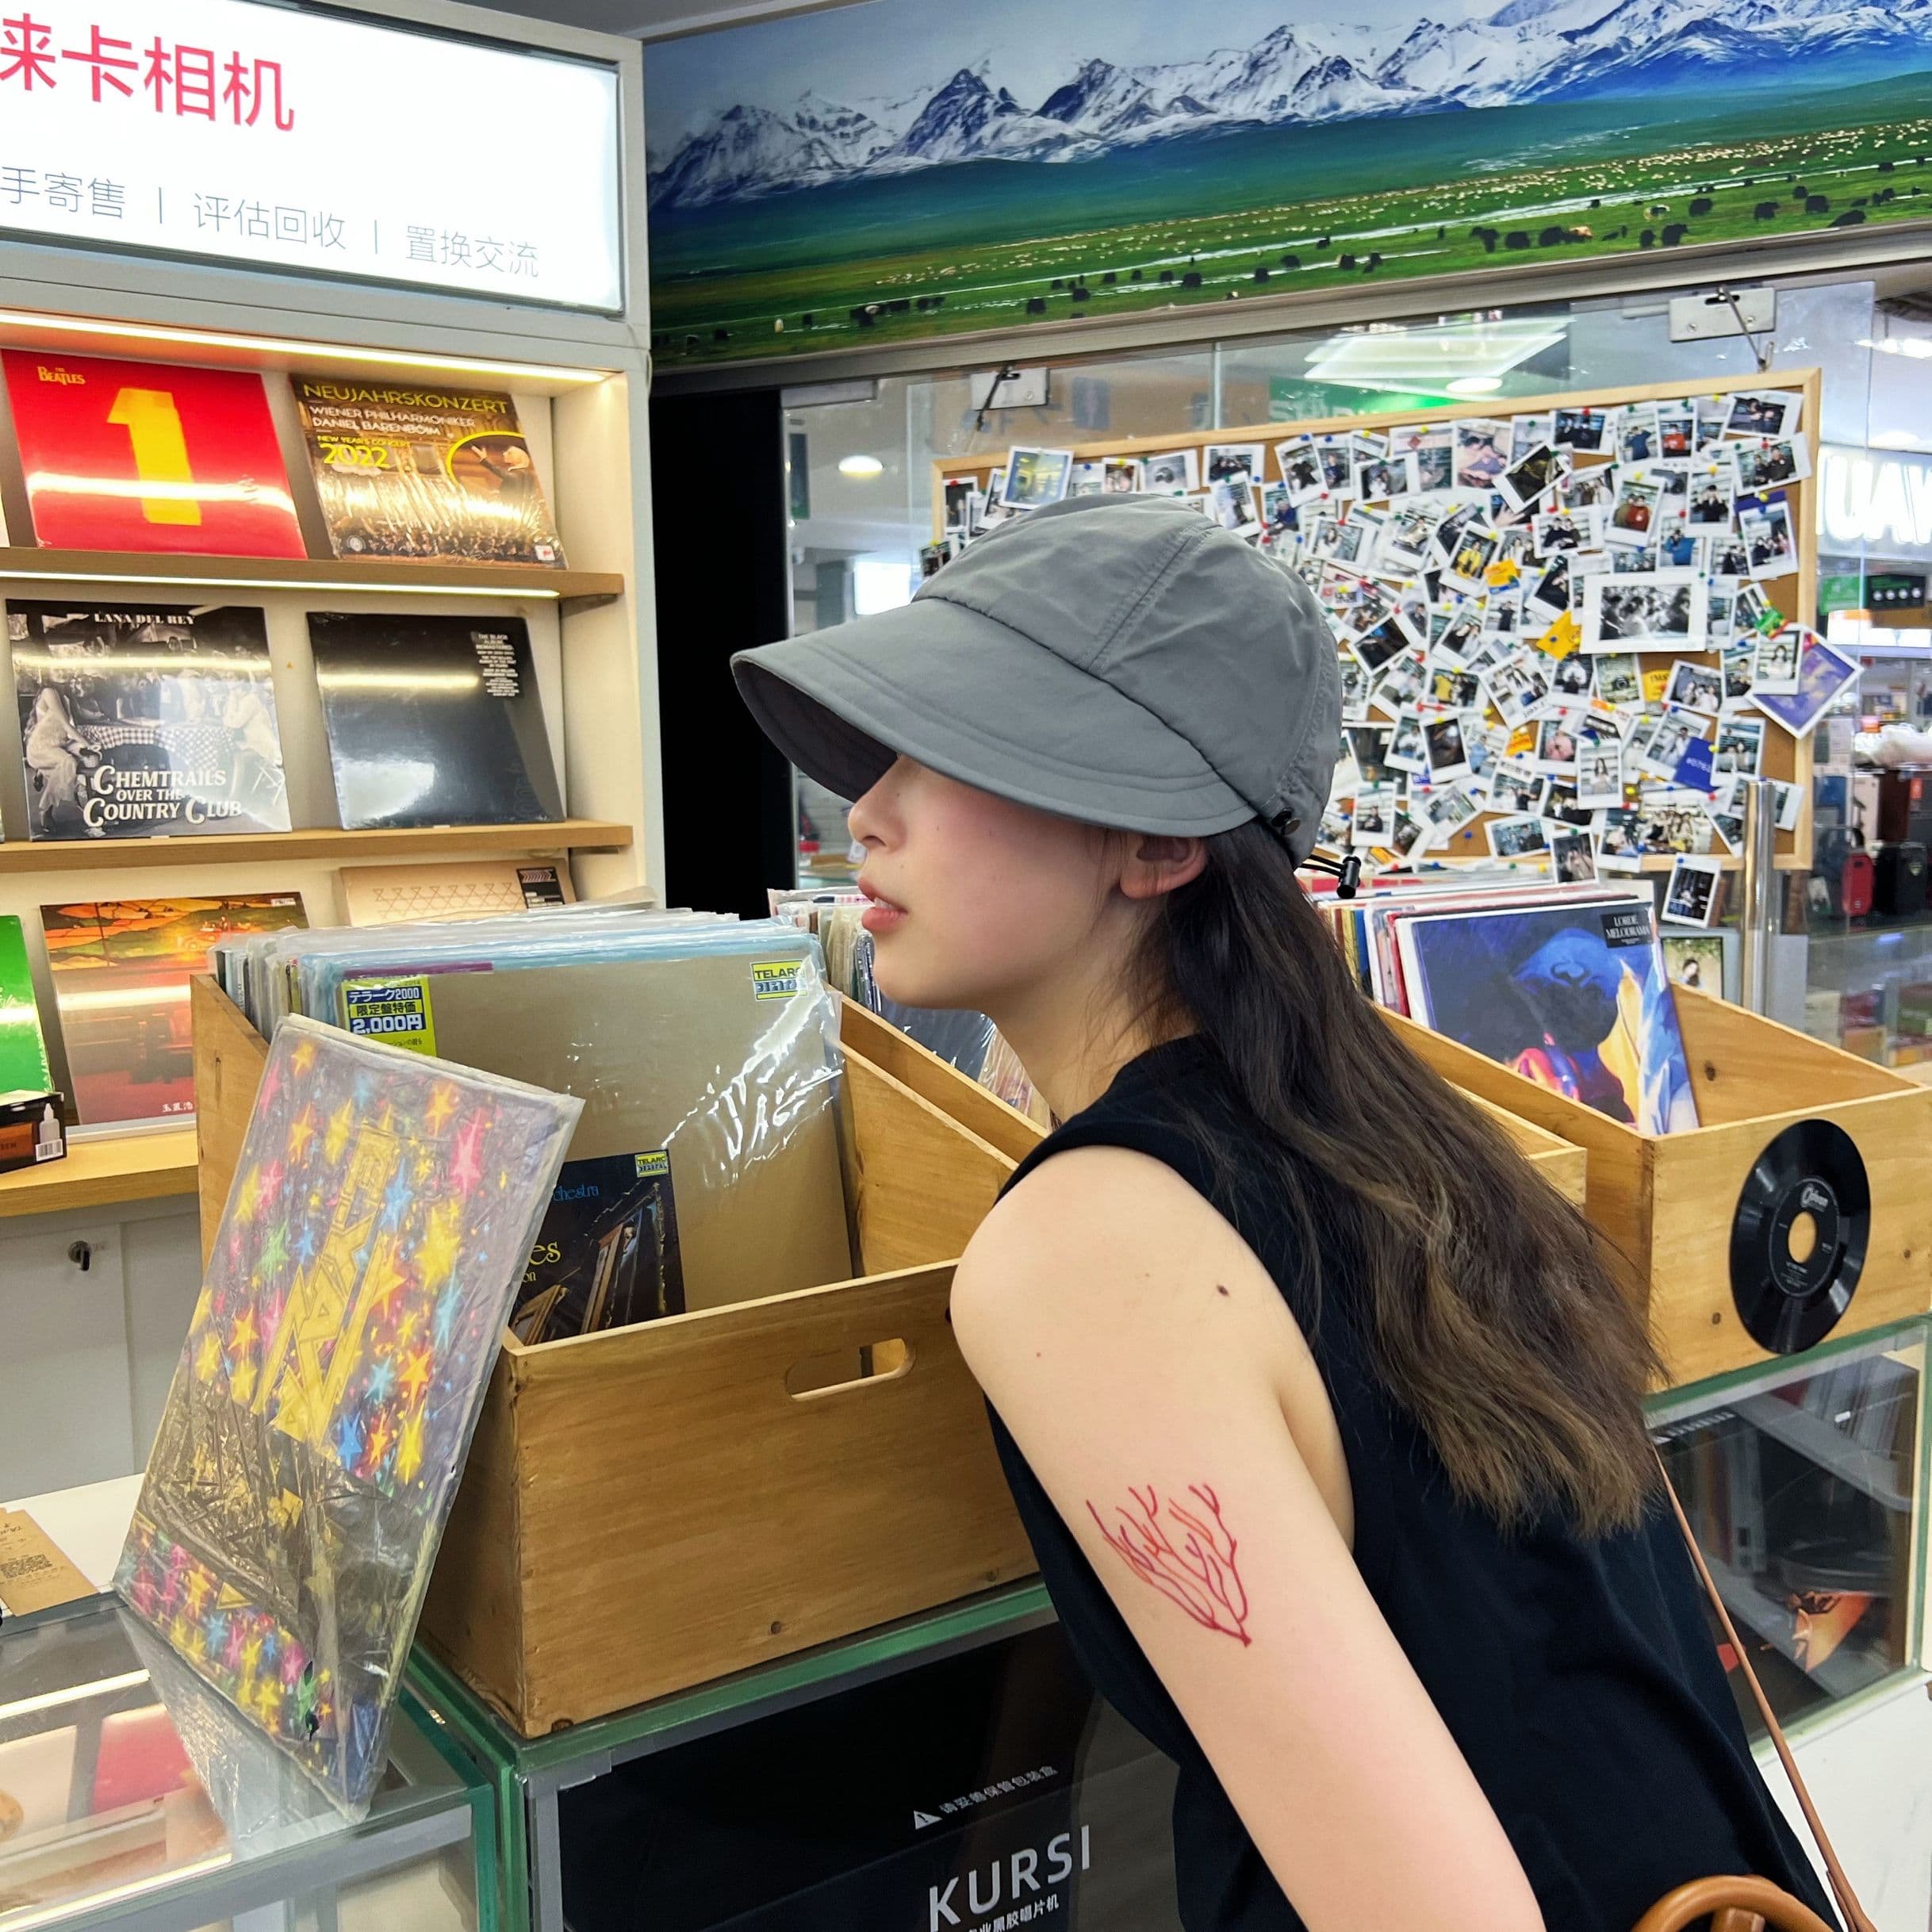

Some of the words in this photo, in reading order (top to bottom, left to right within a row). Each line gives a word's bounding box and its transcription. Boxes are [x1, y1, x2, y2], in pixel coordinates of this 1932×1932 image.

[193, 192, 346, 250] 评估回收
[406, 225, 539, 278] 置换交流
[38, 366, 86, 385] BEATLES
[304, 385, 508, 414] NEUJAHRSKONZERT
[309, 405, 362, 419] WIENER
[365, 410, 476, 427] PHILHARMONIKER
[312, 418, 360, 430] DANIEL
[362, 421, 441, 436] BARENBOIM
[106, 388, 202, 527] 1
[320, 443, 390, 468] 2022
[94, 613, 132, 623] LANA
[166, 615, 195, 625] REY
[93, 765, 227, 795] CHEMTRAILS
[116, 789, 152, 802] OVER
[156, 788, 185, 800] THE
[82, 798, 180, 827] COUNTRY
[185, 795, 242, 824] CLUB
[349, 987, 420, 1003] テラーク2000
[356, 1001, 416, 1016] 限定盤特価
[352, 1014, 423, 1034] 2,000円
[638, 1156, 665, 1165] TELARC
[554, 1183, 599, 1202] chestra
[527, 1241, 561, 1265] es
[929, 1825, 1090, 1932] KURSI
